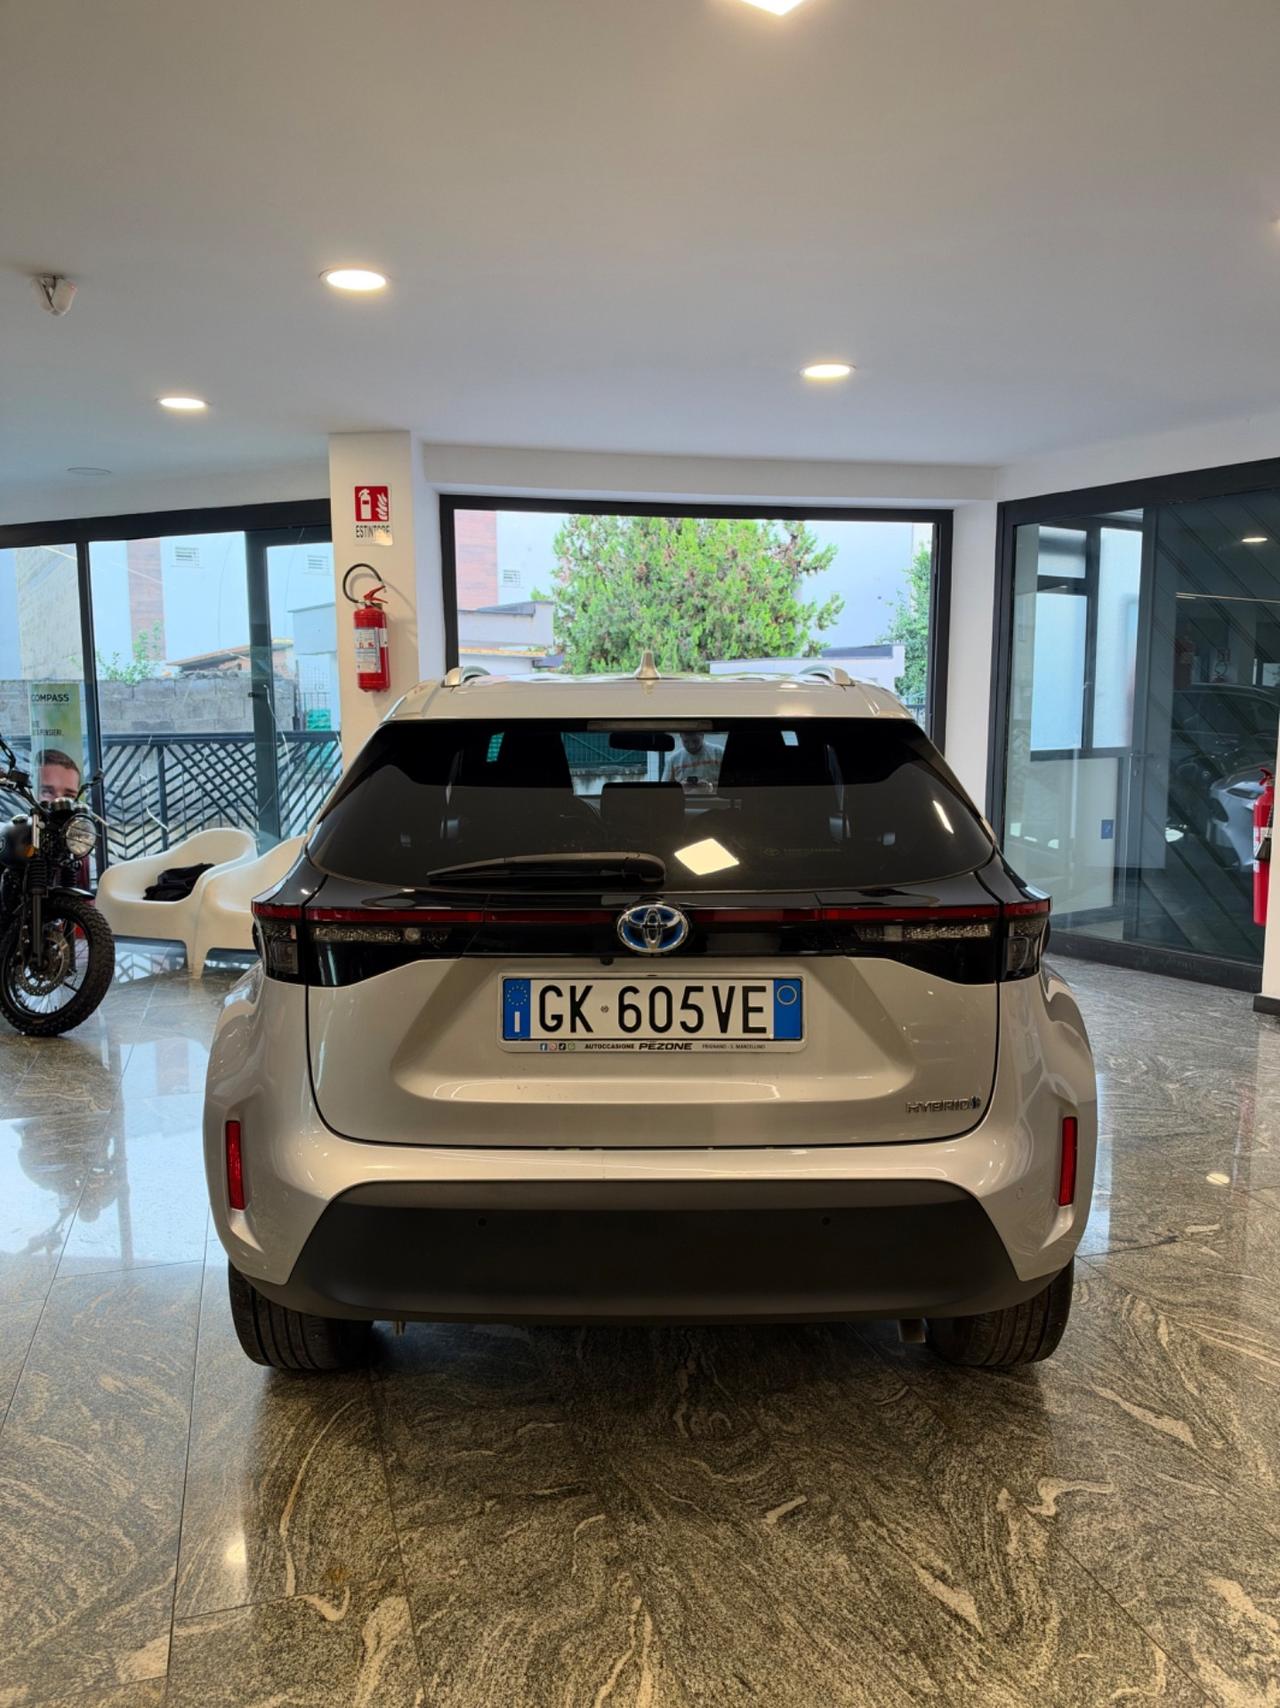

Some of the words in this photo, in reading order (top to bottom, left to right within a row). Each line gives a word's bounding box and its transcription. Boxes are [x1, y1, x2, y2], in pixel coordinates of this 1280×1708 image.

[356, 525, 390, 538] ESTINTE
[539, 984, 594, 1033] GK
[618, 985, 767, 1034] 605VE
[638, 1042, 693, 1051] PEZONE
[905, 1099, 971, 1113] HYBRID
